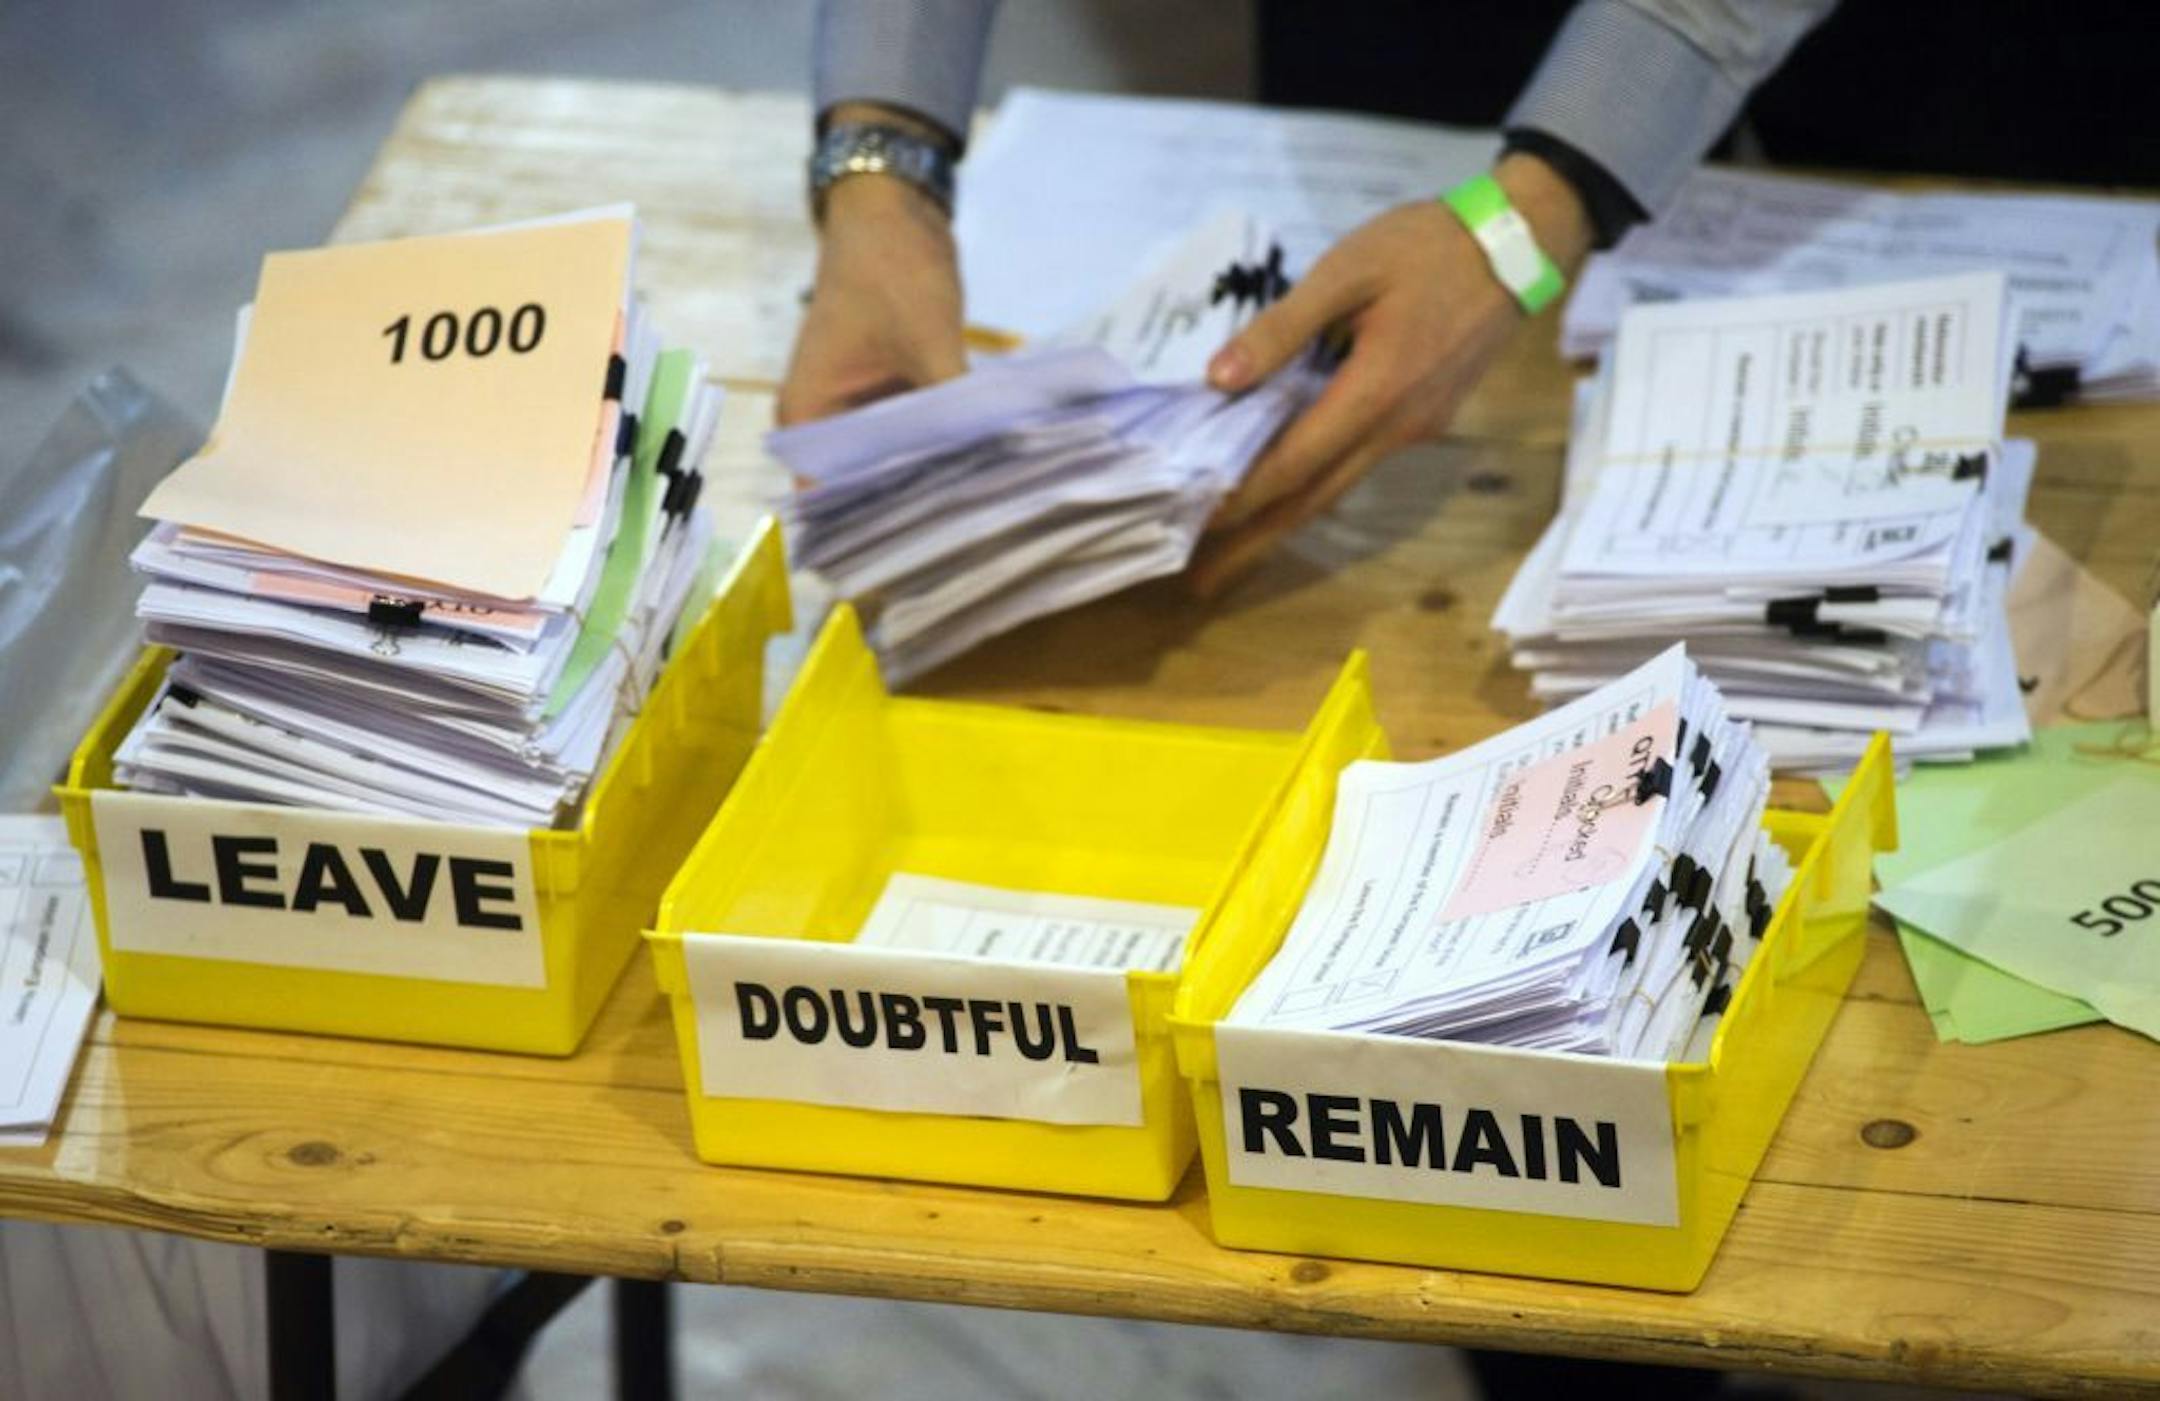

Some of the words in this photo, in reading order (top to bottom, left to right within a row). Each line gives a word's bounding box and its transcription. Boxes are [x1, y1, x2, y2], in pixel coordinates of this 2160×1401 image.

[381, 303, 546, 364] 1000
[1553, 759, 1594, 821] Initials
[1564, 784, 1614, 862] Ccked
[138, 827, 524, 932] LEAVE
[2069, 879, 2160, 938] 500
[732, 980, 1101, 1066] DOUBTFUL
[1237, 1086, 1622, 1190] REMAIN
